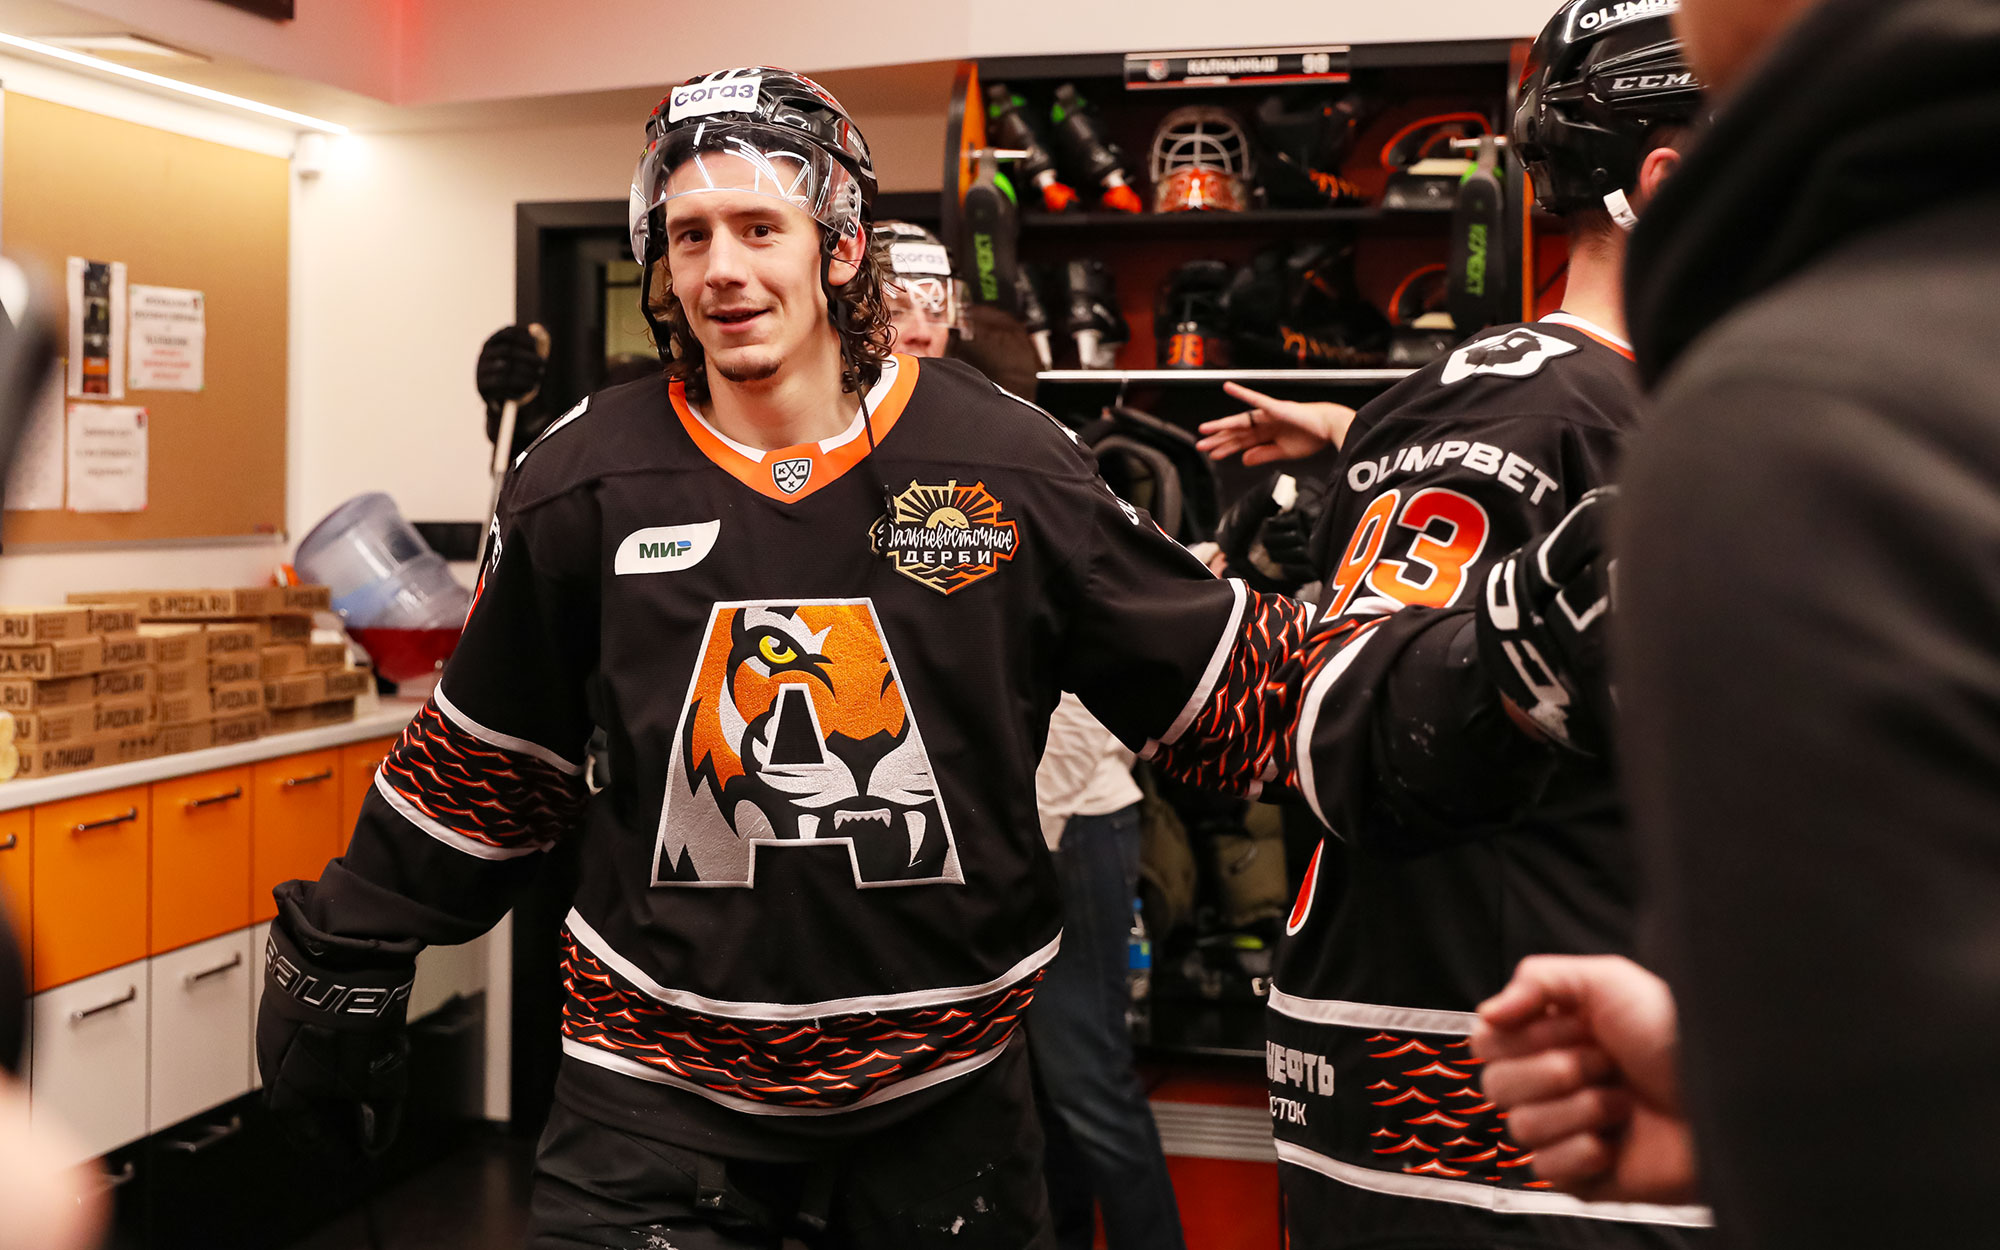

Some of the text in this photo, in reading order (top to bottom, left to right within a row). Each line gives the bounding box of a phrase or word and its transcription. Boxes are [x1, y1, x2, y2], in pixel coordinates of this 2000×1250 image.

[1612, 72, 1692, 90] CCM
[1347, 440, 1559, 506] OLIMPBET
[639, 540, 692, 559] МИР
[904, 550, 991, 564] ДЕРБИ
[1320, 487, 1490, 622] 93
[1266, 1039, 1335, 1097] НЕФТЬ
[1268, 1091, 1307, 1126] СТОК
